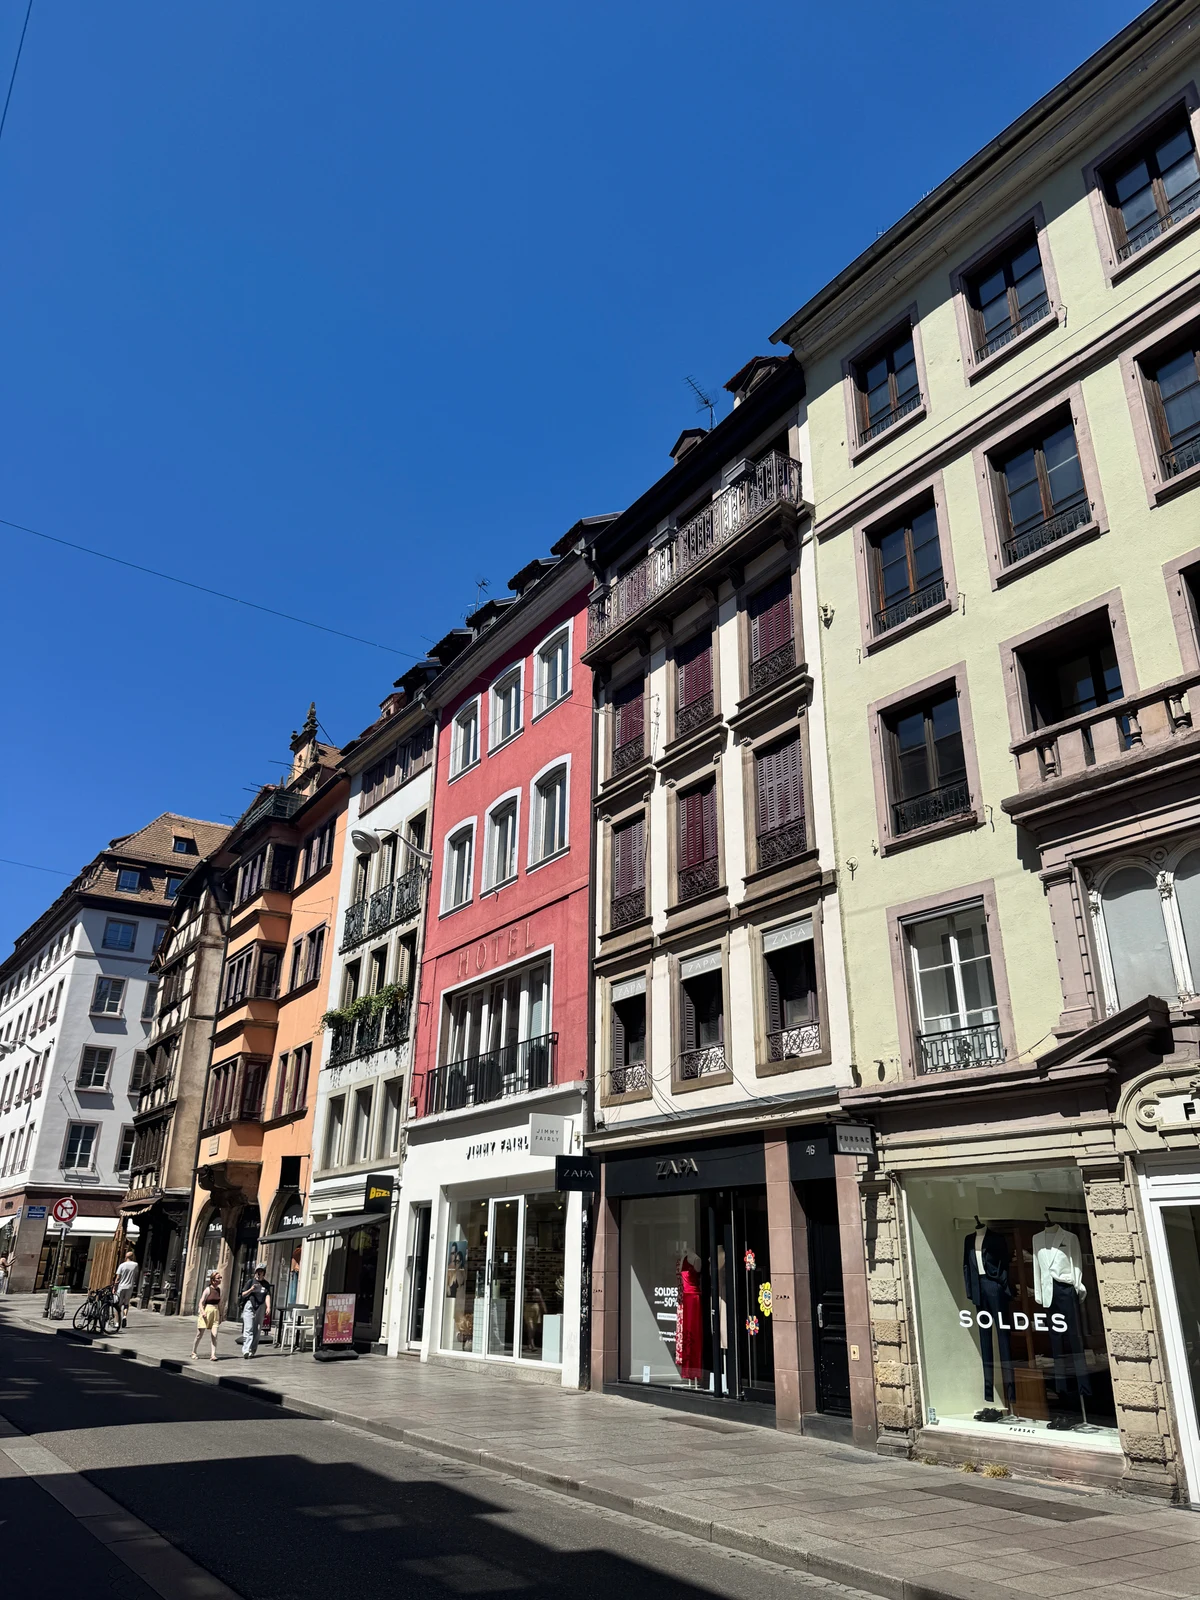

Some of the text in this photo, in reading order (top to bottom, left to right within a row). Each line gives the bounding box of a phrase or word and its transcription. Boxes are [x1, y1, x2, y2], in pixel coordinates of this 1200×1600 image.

[772, 928, 806, 945] ZAPA
[457, 921, 536, 977] HOTEL
[688, 957, 717, 973] ZAPA
[617, 982, 642, 997] ZAPA
[839, 1135, 870, 1143] FURSAC
[466, 1136, 529, 1160] JIMMY FAIRL
[805, 1144, 815, 1155] 46
[563, 1169, 594, 1178] ZAPA
[656, 1158, 700, 1180] ZAPA
[654, 1287, 678, 1297] SOLDES
[959, 1310, 1068, 1333] SOLDES
